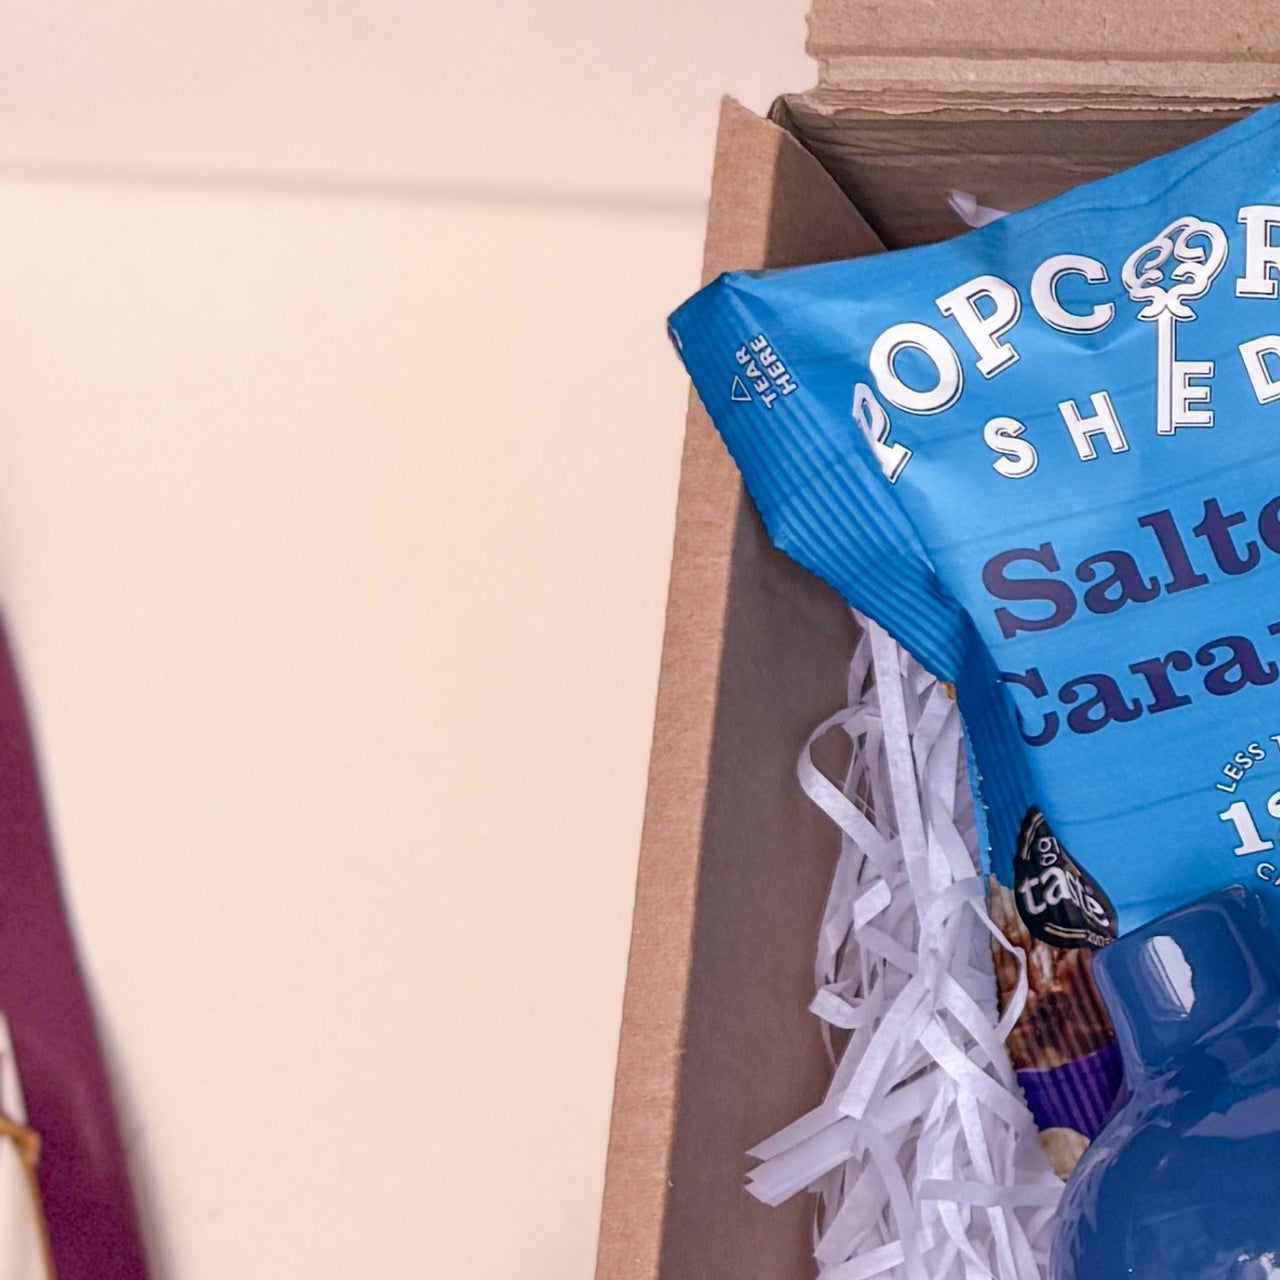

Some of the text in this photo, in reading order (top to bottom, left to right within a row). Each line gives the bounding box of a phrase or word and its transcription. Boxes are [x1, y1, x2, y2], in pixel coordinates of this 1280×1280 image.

[735, 345, 777, 409] TEAR
[749, 334, 798, 396] HERE
[1216, 742, 1267, 793] LESS
